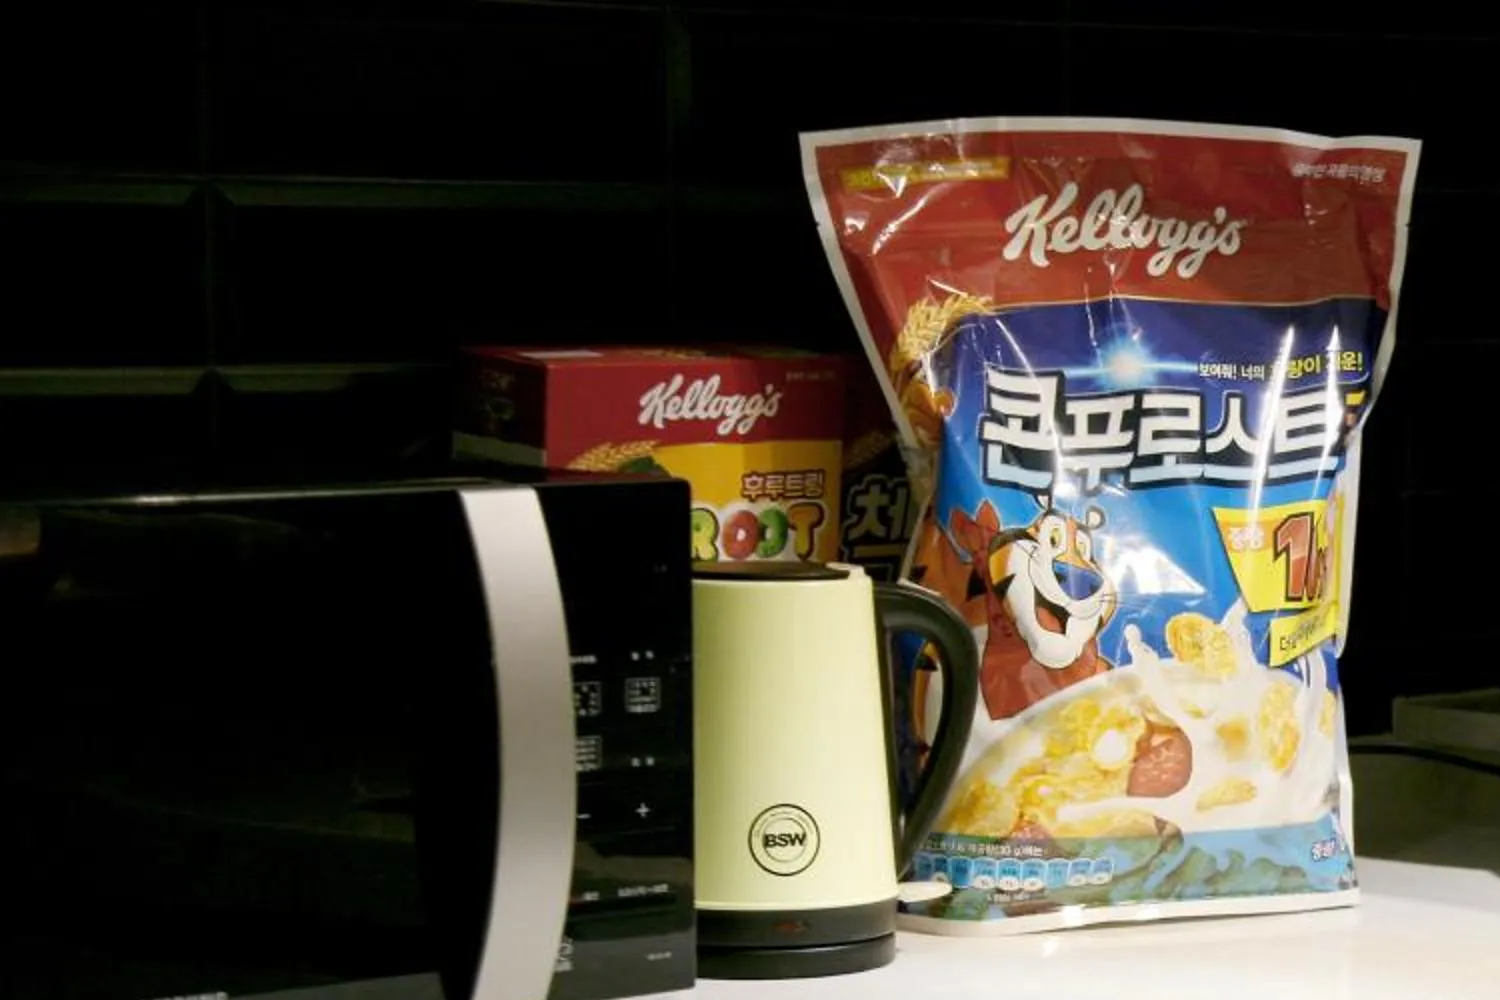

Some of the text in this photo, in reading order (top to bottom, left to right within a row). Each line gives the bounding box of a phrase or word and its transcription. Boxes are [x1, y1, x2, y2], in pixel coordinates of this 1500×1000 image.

[1003, 180, 1245, 279] Kellogg's
[1272, 354, 1320, 379] 랑이
[638, 373, 782, 436] Kellogg's
[980, 364, 1347, 490] 콘푸로스트
[741, 472, 825, 500] 후루트링
[690, 501, 826, 561] ROOT
[763, 832, 806, 848] BSW
